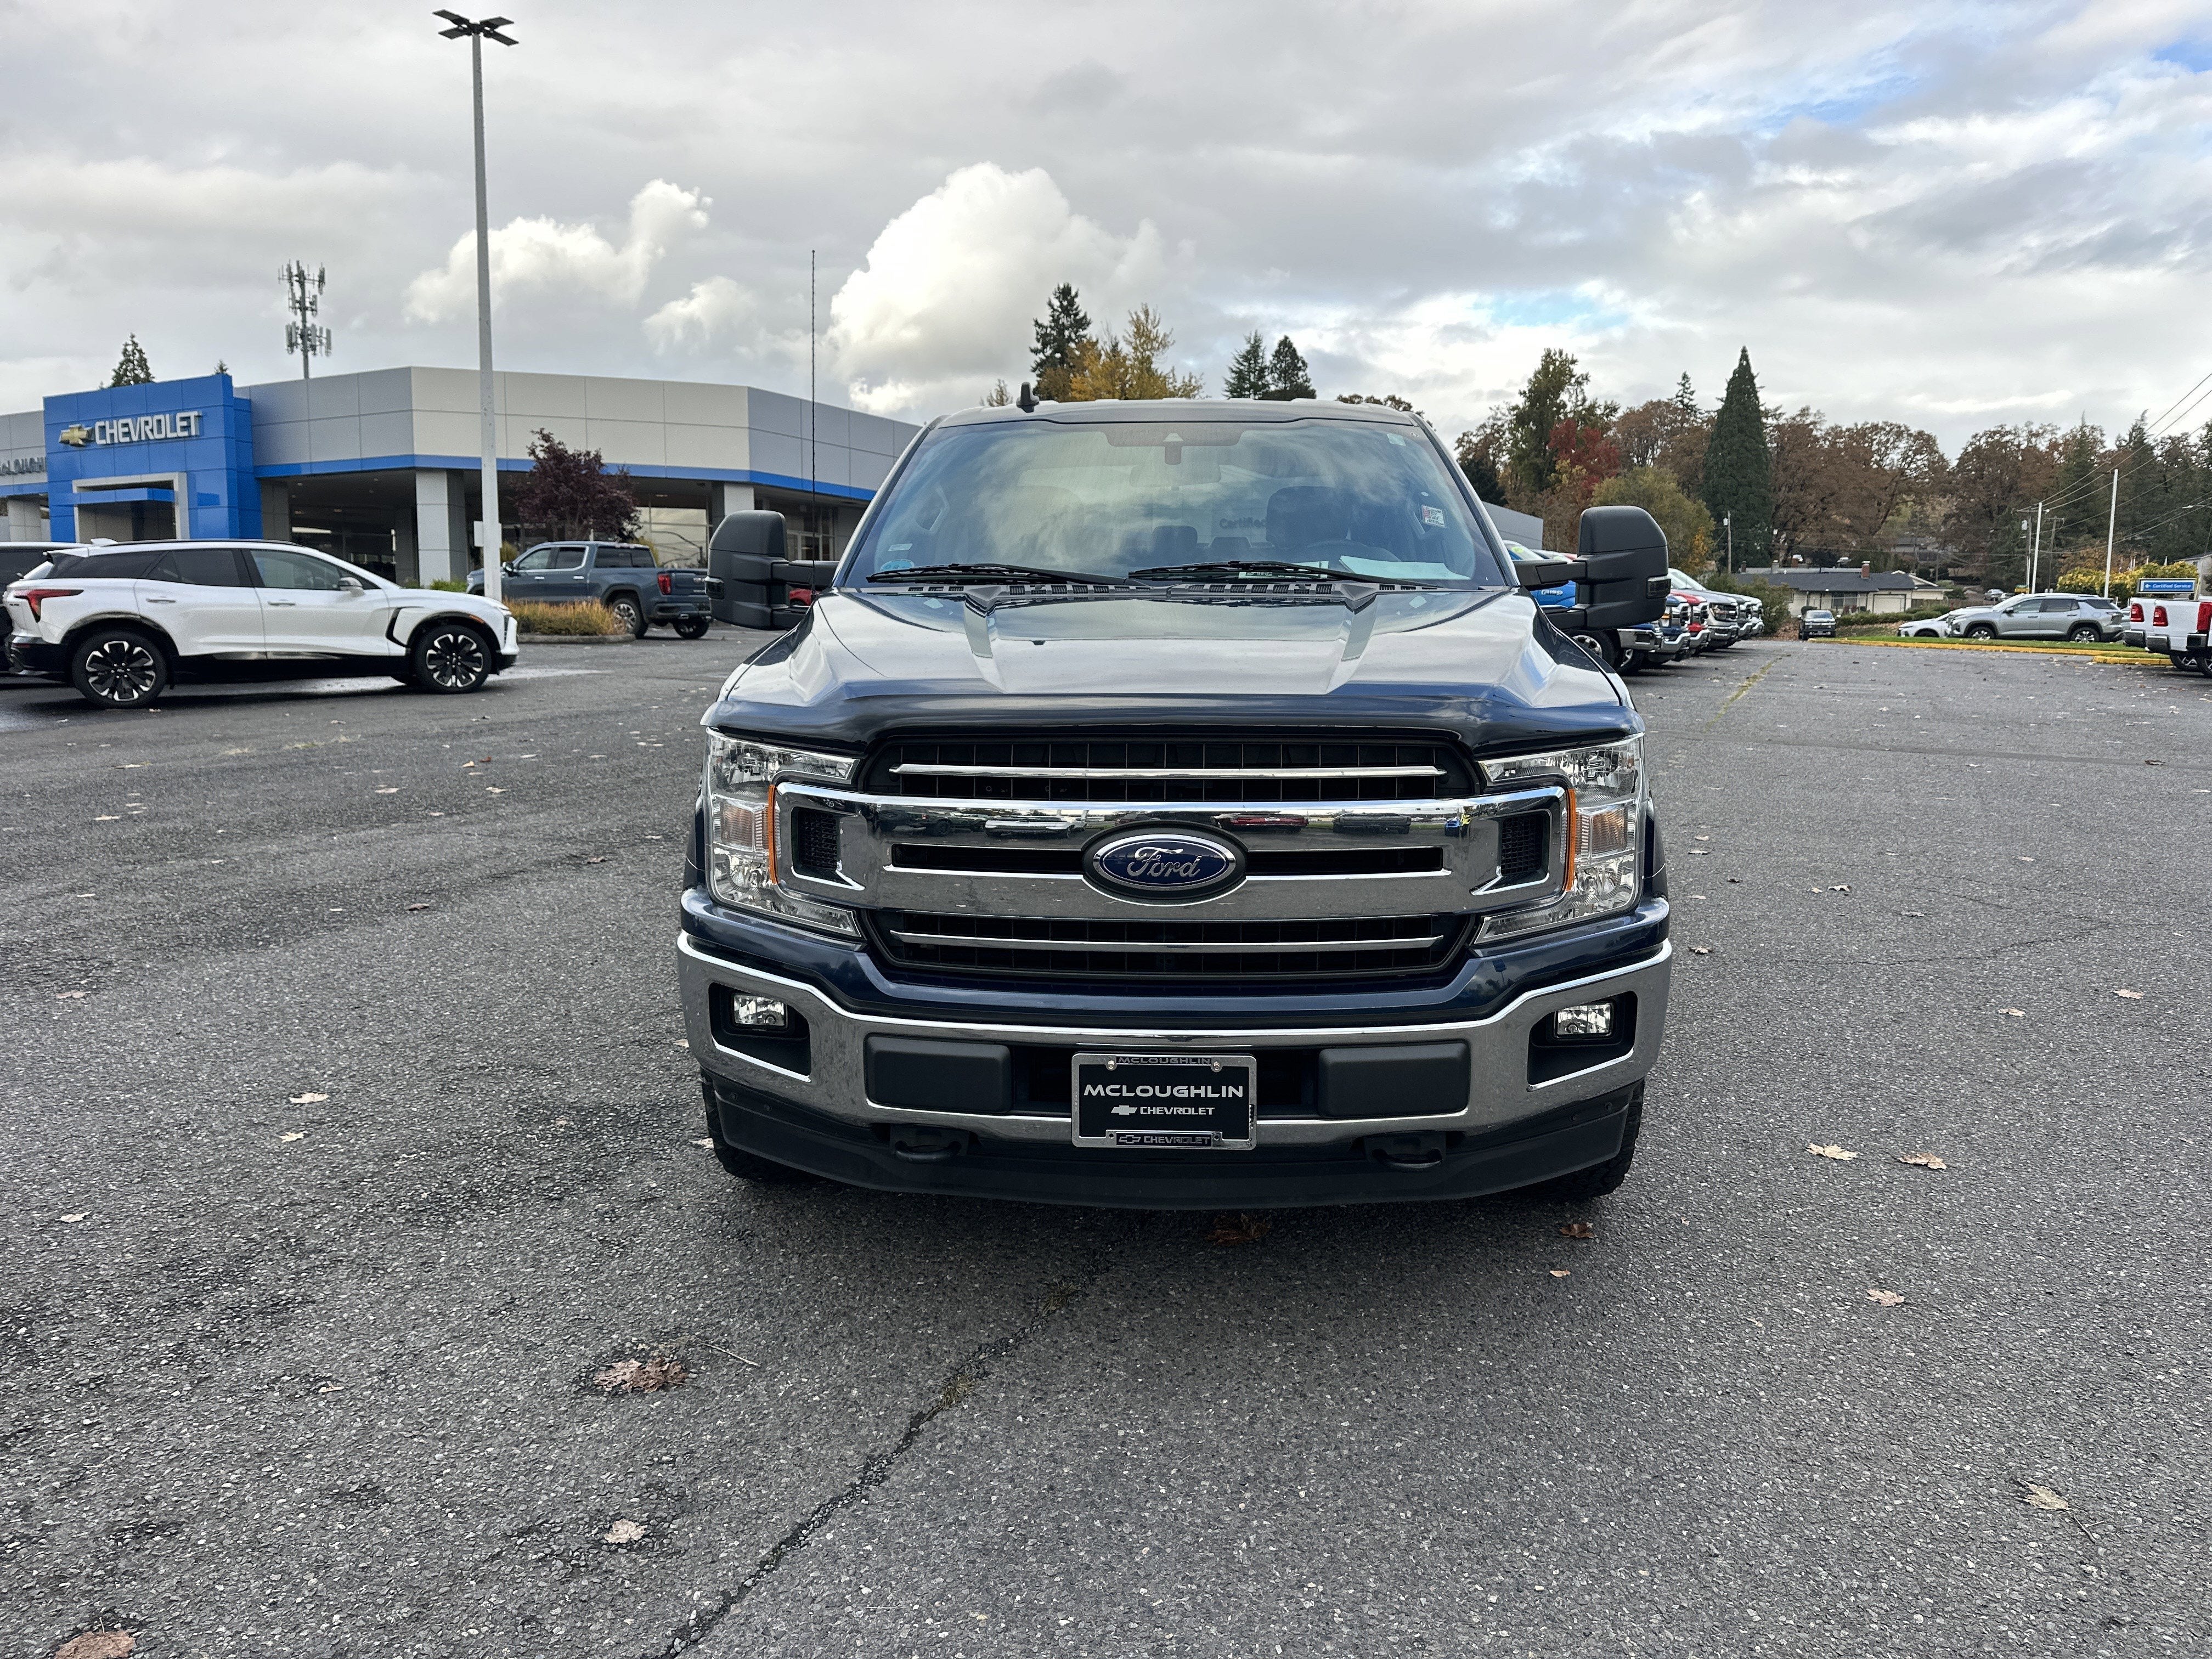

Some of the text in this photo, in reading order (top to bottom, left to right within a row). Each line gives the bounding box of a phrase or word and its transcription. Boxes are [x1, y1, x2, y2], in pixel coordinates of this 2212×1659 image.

[95, 410, 202, 445] CHEVROLET
[1126, 846, 1203, 878] Ford
[1118, 1056, 1211, 1065] MCLOUGHLIN
[1084, 1084, 1244, 1098] MCLOUGHLIN
[1140, 1106, 1215, 1115] CHEVROLET
[1143, 1135, 1210, 1144] CHEVROLET
